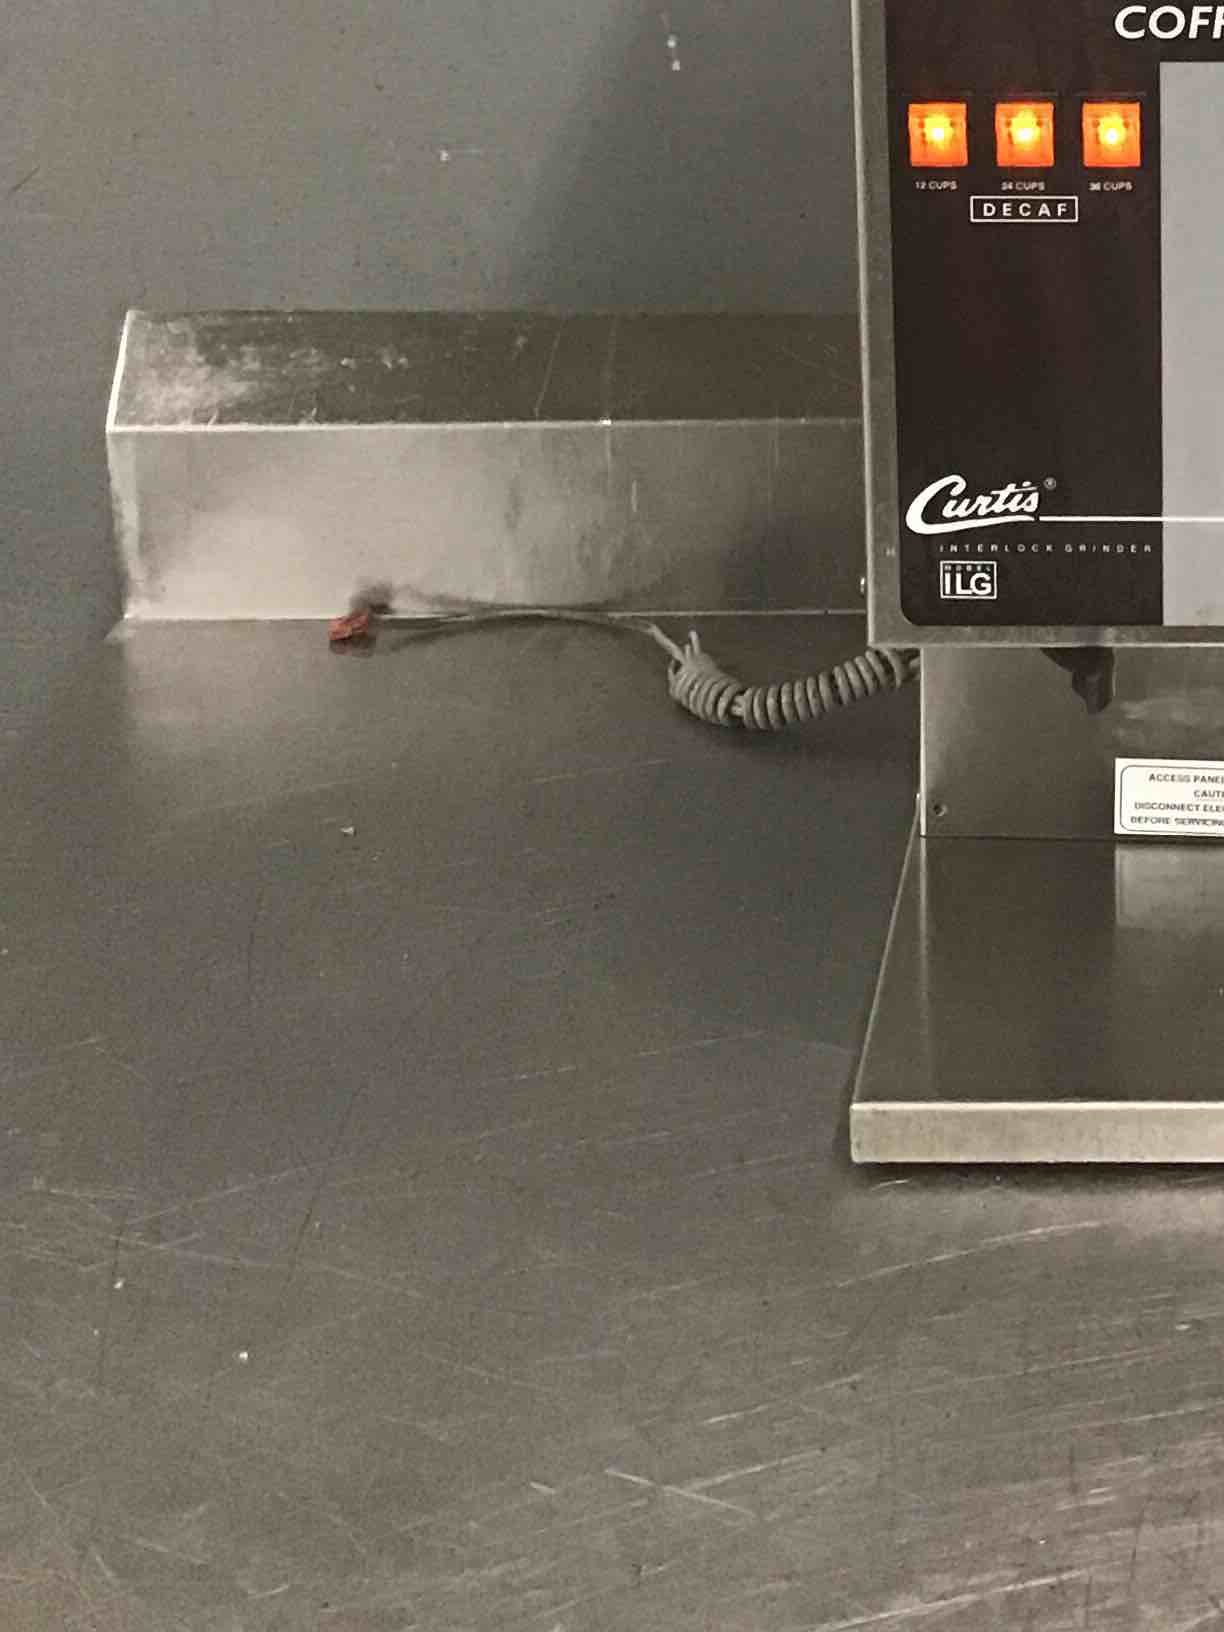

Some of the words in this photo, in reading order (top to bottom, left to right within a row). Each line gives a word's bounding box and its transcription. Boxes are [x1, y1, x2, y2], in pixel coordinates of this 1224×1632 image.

[915, 181, 926, 189] 12
[929, 181, 957, 190] CUPS
[1016, 182, 1045, 190] CUPS
[1104, 182, 1132, 191] CUPS
[983, 203, 1068, 217] DECAF
[939, 544, 1053, 552] INTERLOCK
[1064, 544, 1151, 552] GRINDER
[944, 572, 992, 595] ILG
[1148, 773, 1191, 783] ACCESS
[1134, 802, 1200, 812] DISCONNECT
[1130, 816, 1170, 825] BEFORE
